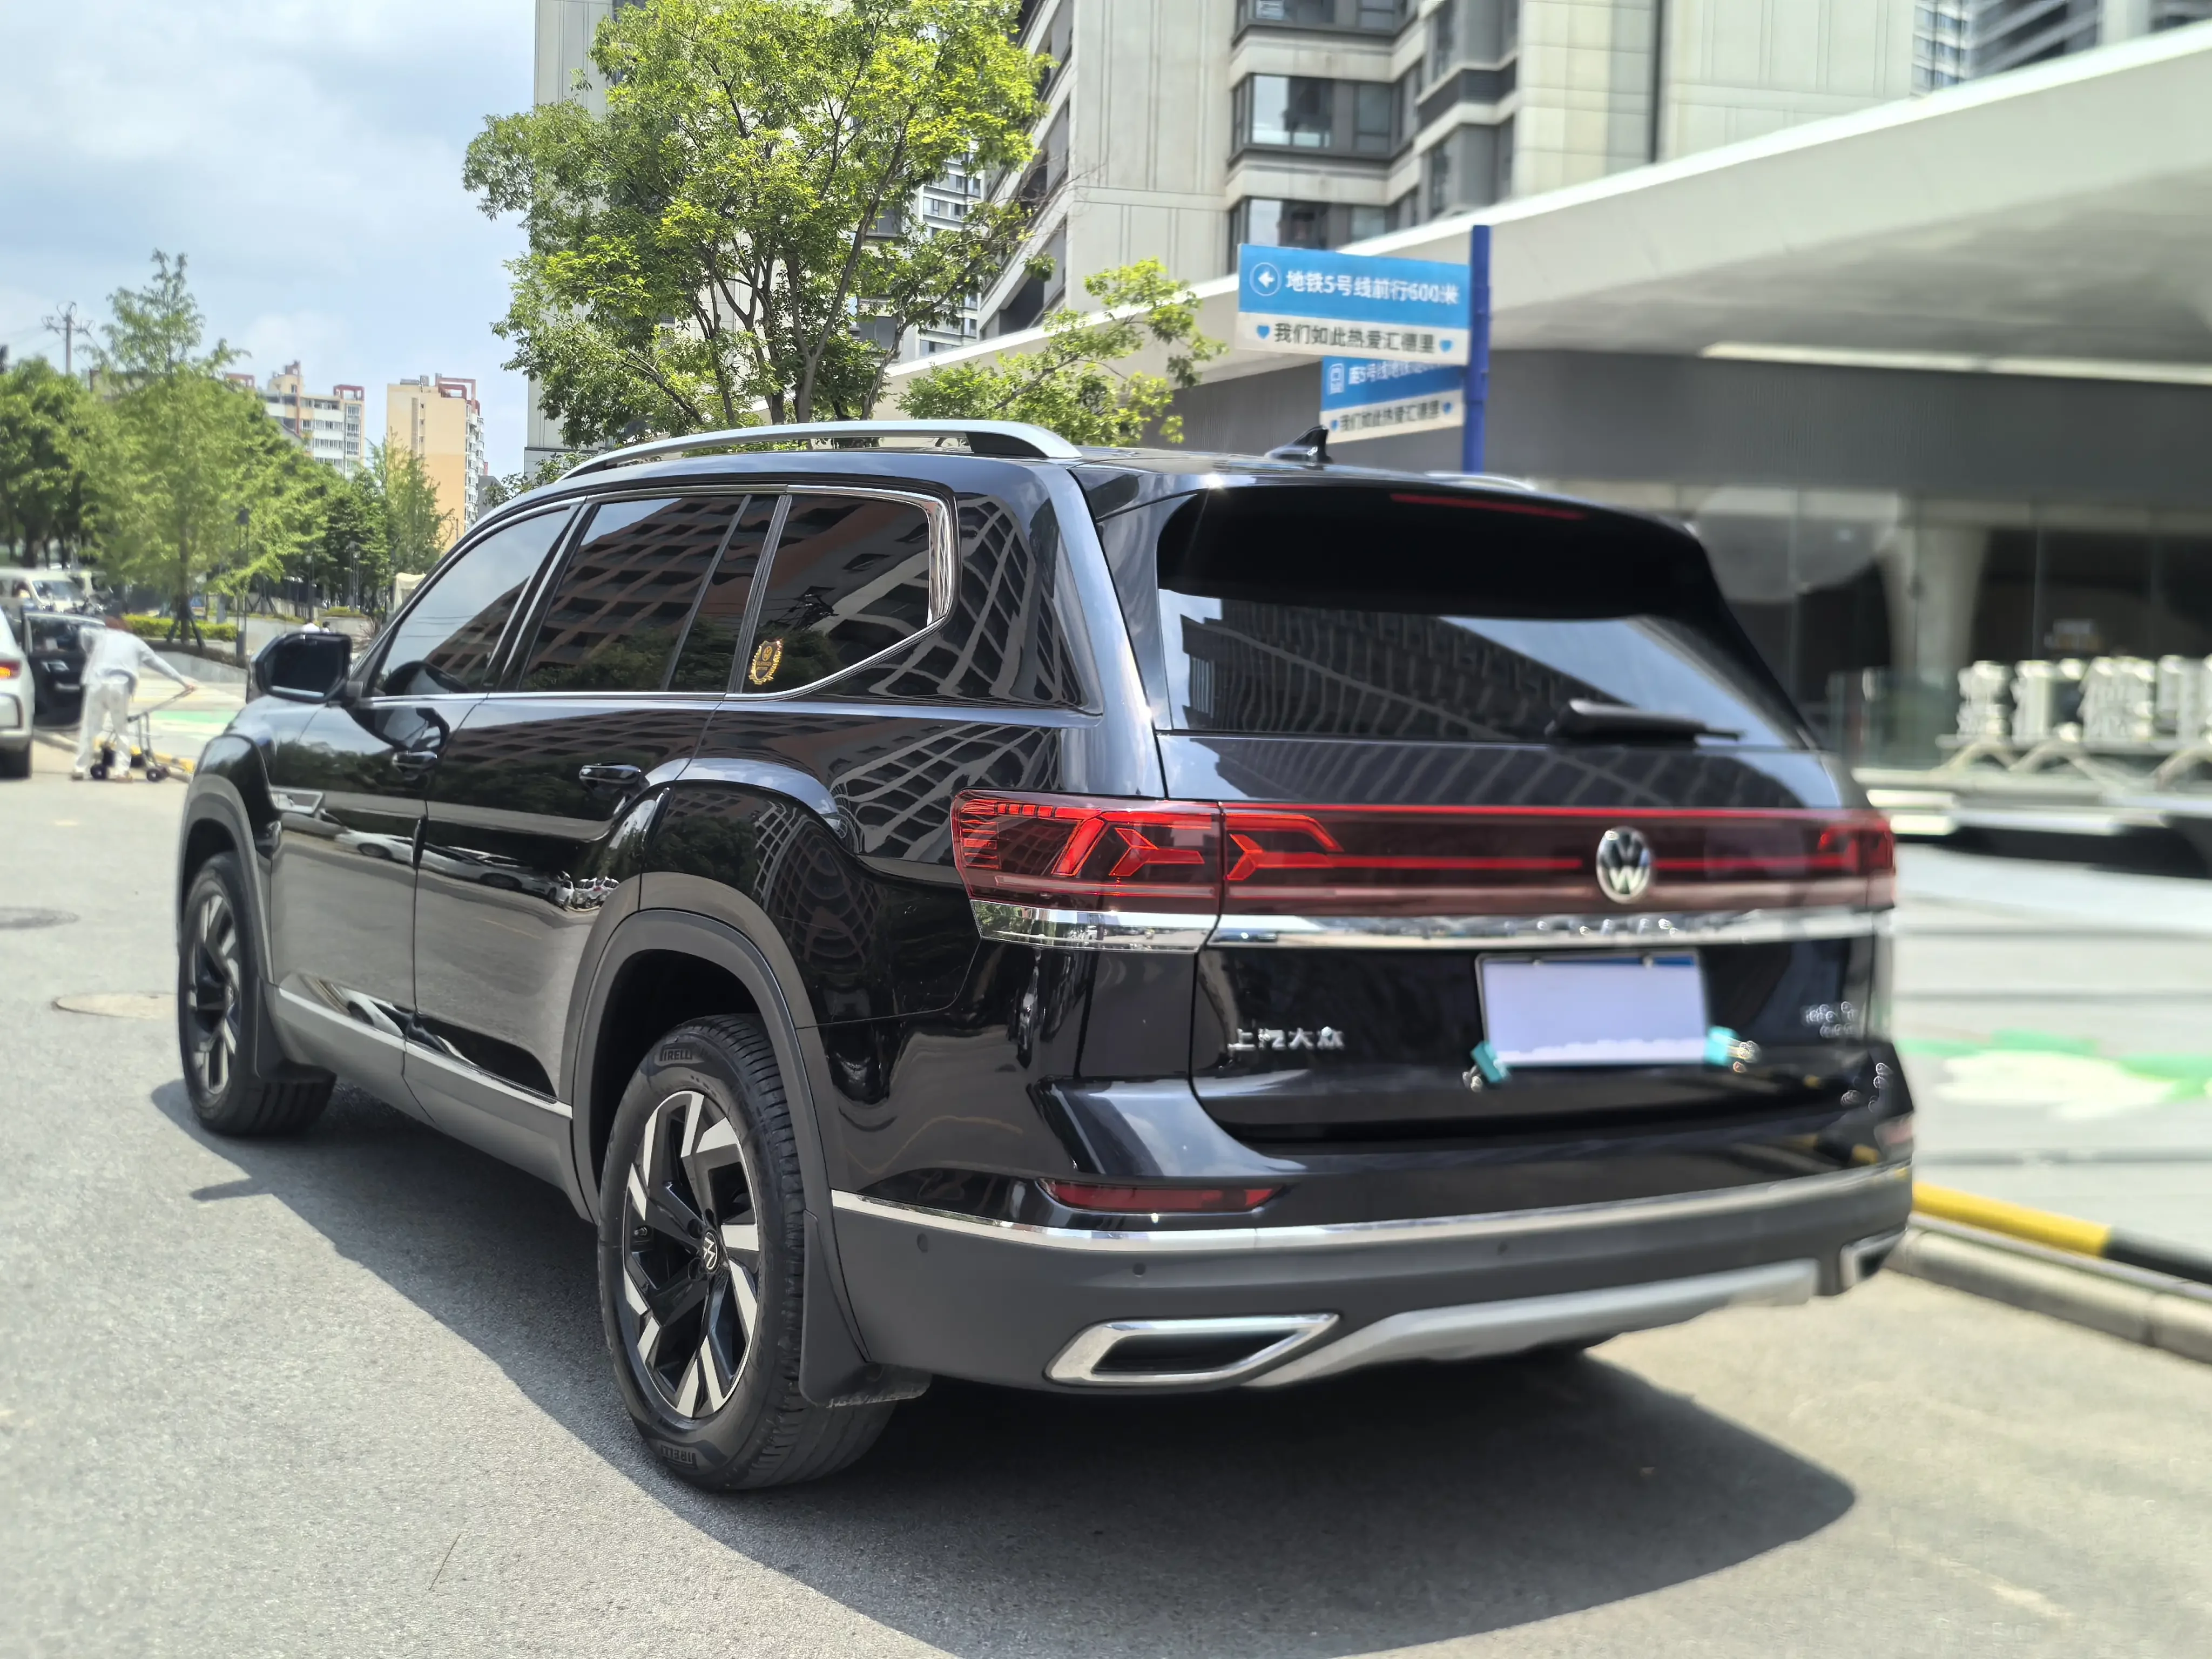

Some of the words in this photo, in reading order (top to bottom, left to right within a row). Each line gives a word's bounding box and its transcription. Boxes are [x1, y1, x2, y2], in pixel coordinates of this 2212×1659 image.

[1284, 269, 1460, 305] 地铁5号线前行600米
[1274, 322, 1435, 354] 我们如此热爱汇德里
